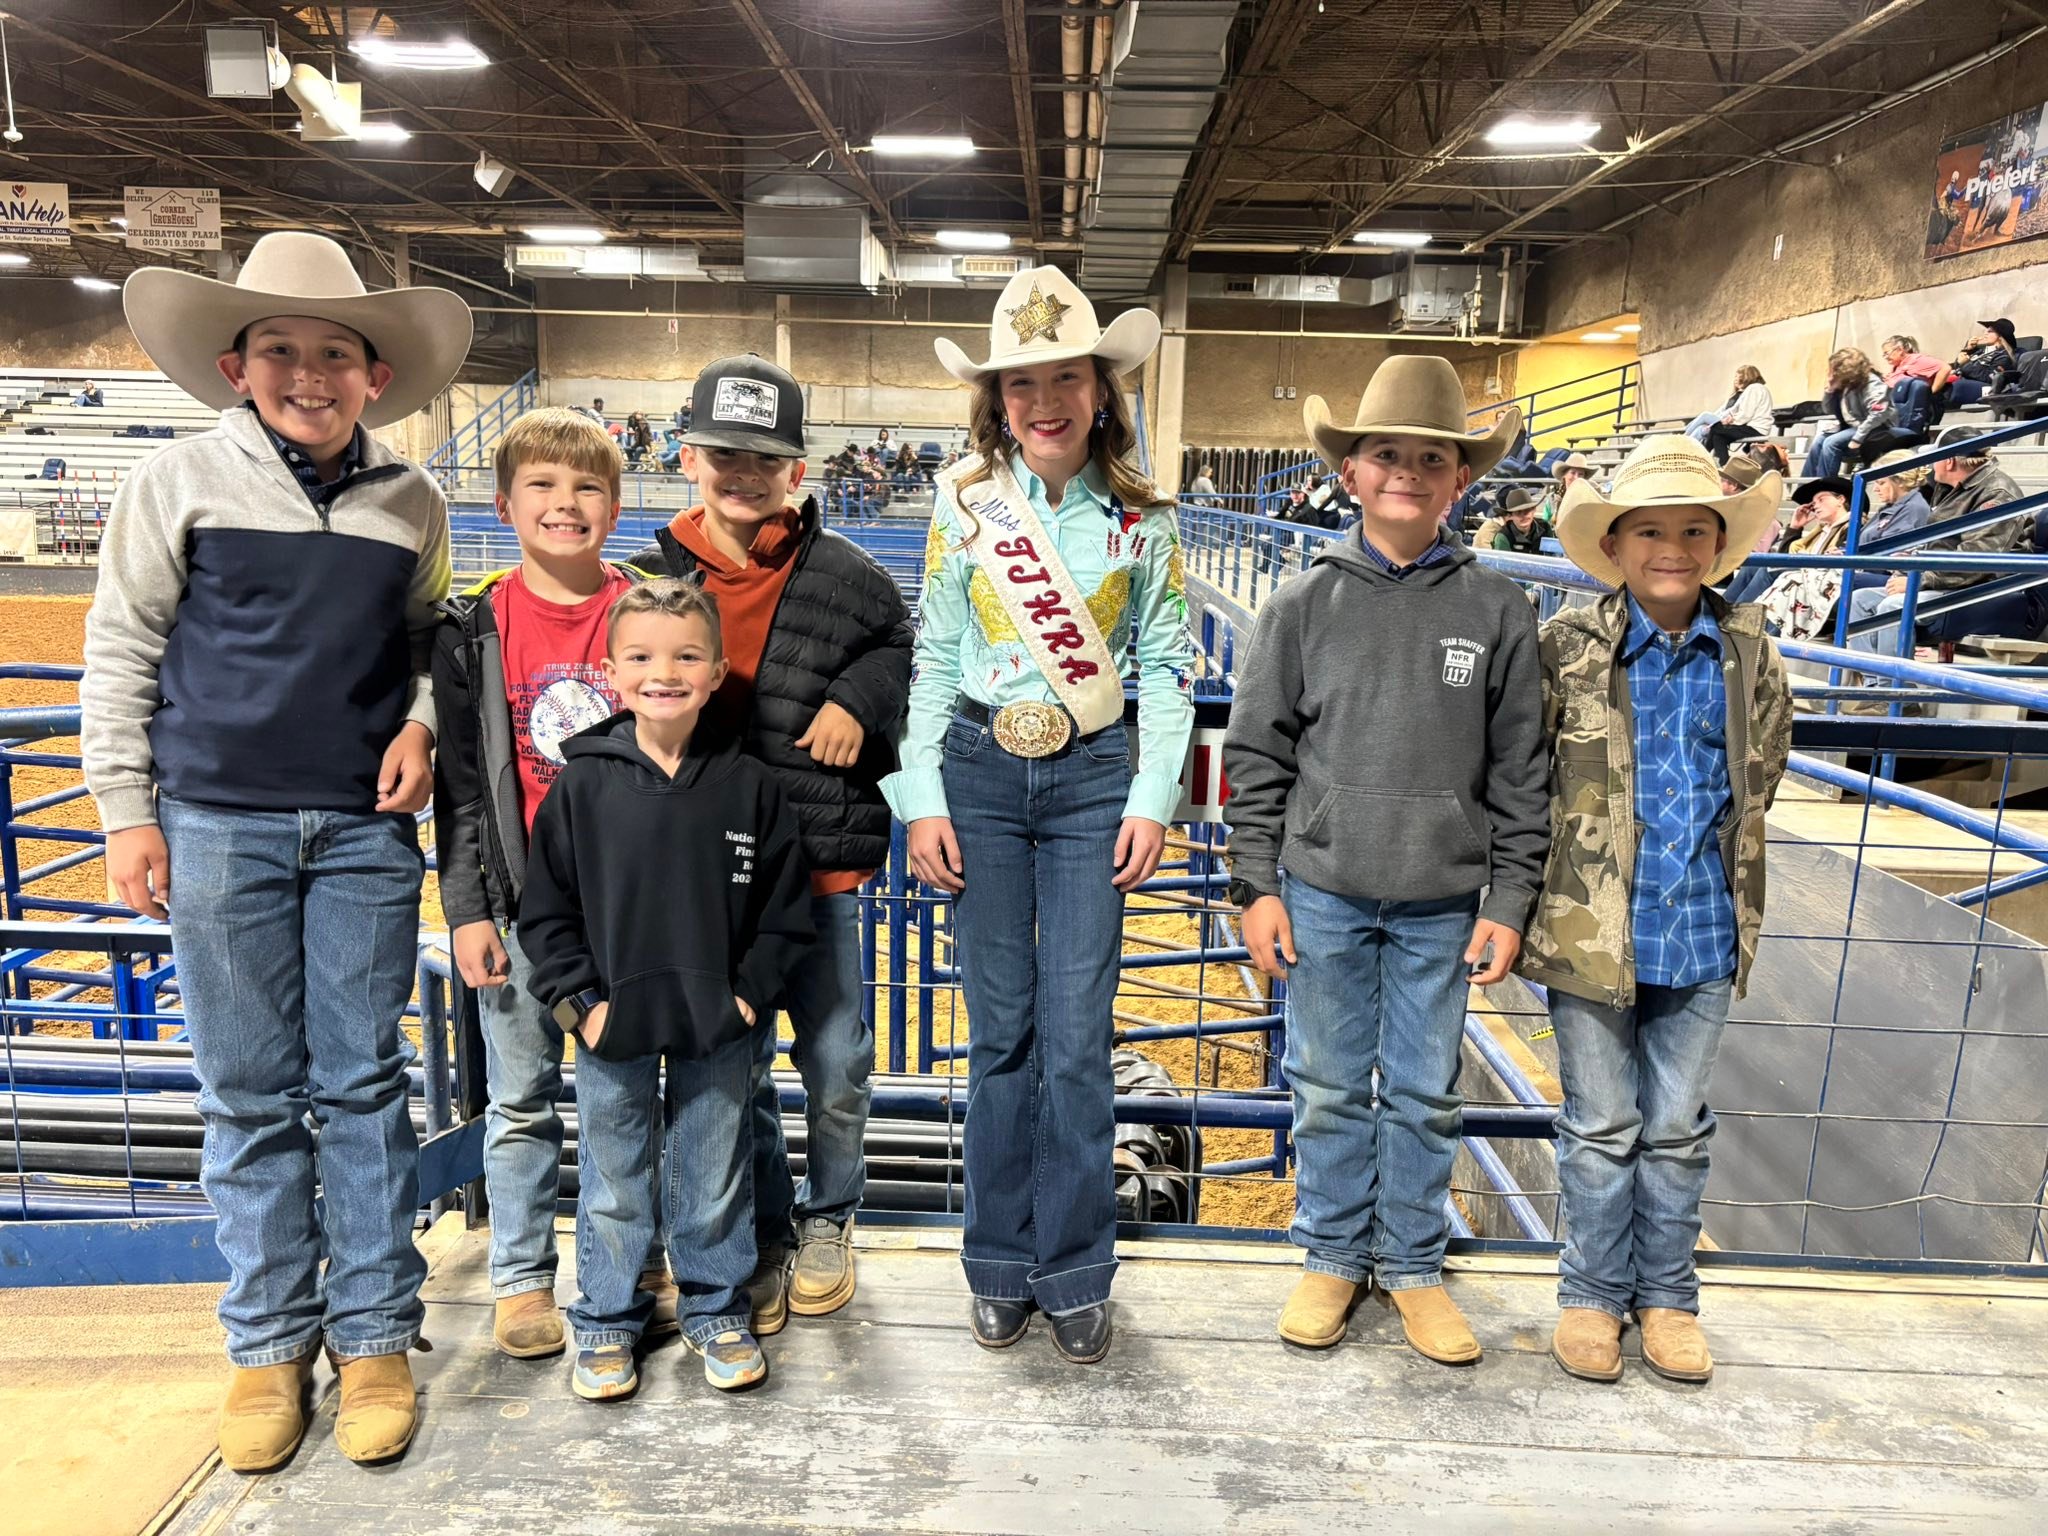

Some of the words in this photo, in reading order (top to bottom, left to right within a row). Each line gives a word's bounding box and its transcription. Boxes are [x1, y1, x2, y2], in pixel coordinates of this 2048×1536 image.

[160, 206, 186, 214] CORNER
[127, 229, 188, 238] CELEBRATION
[192, 231, 220, 239] PLAZA
[969, 498, 1021, 532] Miss
[1439, 637, 1457, 647] TEAM
[1458, 637, 1485, 655] SHAFFER
[1451, 652, 1469, 662] NFR
[1446, 667, 1469, 683] 117
